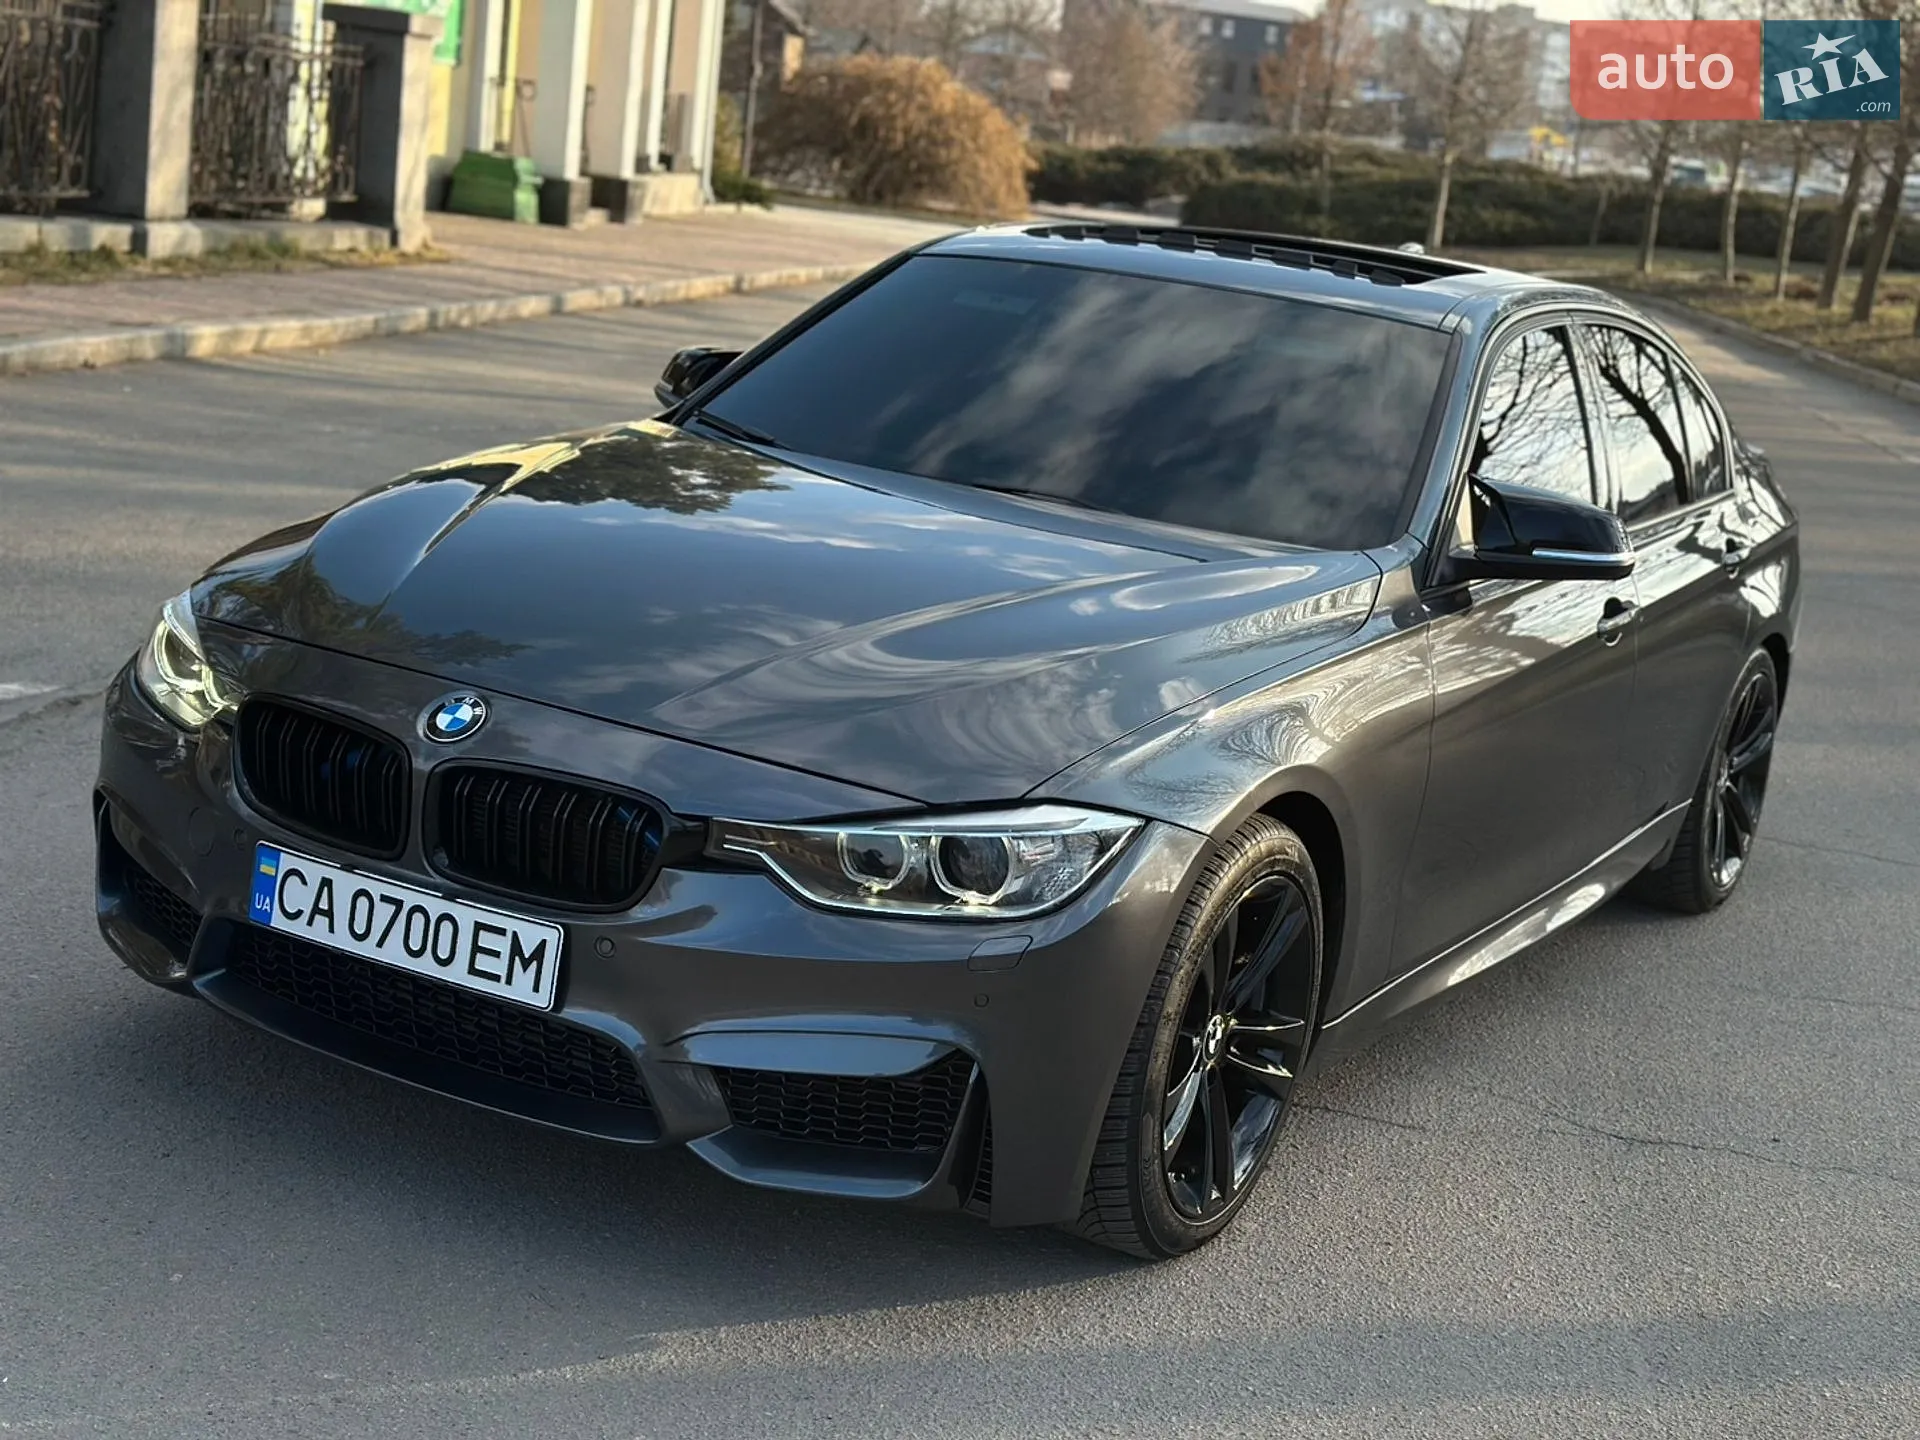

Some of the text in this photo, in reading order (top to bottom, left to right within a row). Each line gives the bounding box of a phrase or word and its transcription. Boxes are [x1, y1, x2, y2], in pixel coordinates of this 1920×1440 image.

[255, 892, 271, 913] UA
[278, 867, 548, 993] CA 0700 EM
